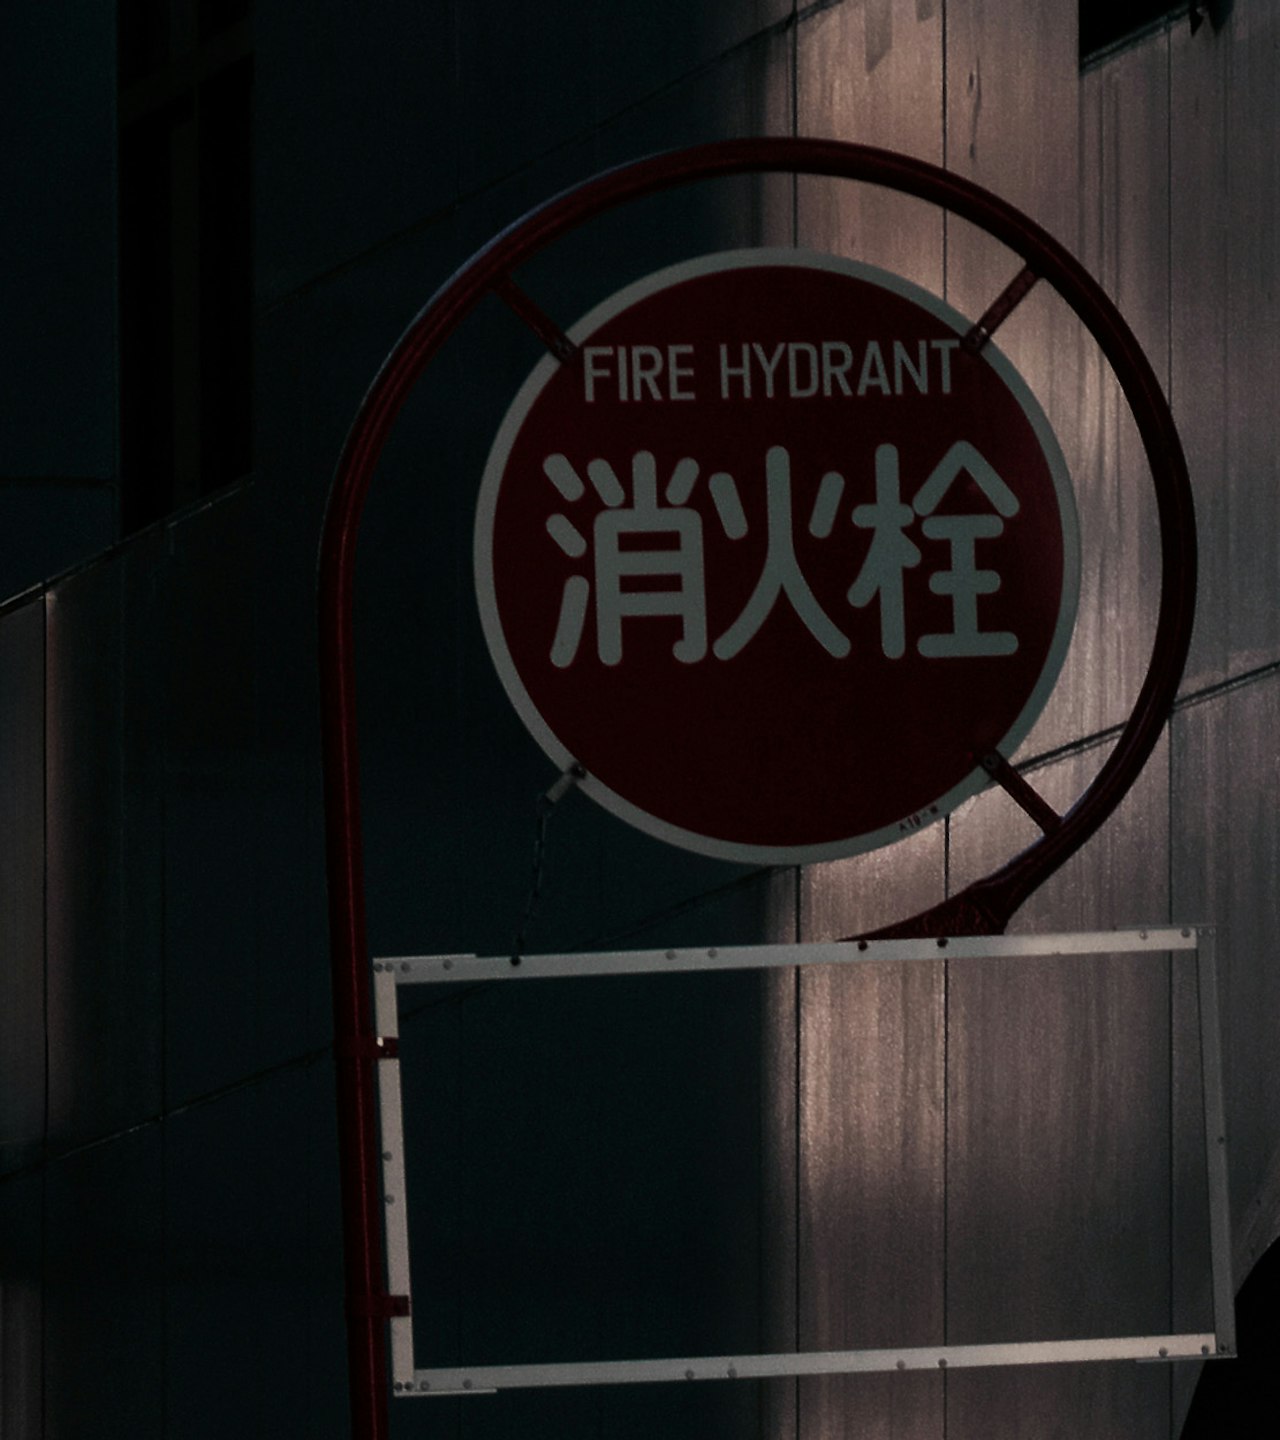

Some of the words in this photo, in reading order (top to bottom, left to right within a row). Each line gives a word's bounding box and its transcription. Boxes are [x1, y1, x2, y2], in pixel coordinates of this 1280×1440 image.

[583, 343, 697, 402] FIRE
[719, 338, 961, 399] HYDRANT
[542, 440, 1020, 669] 消火栓
